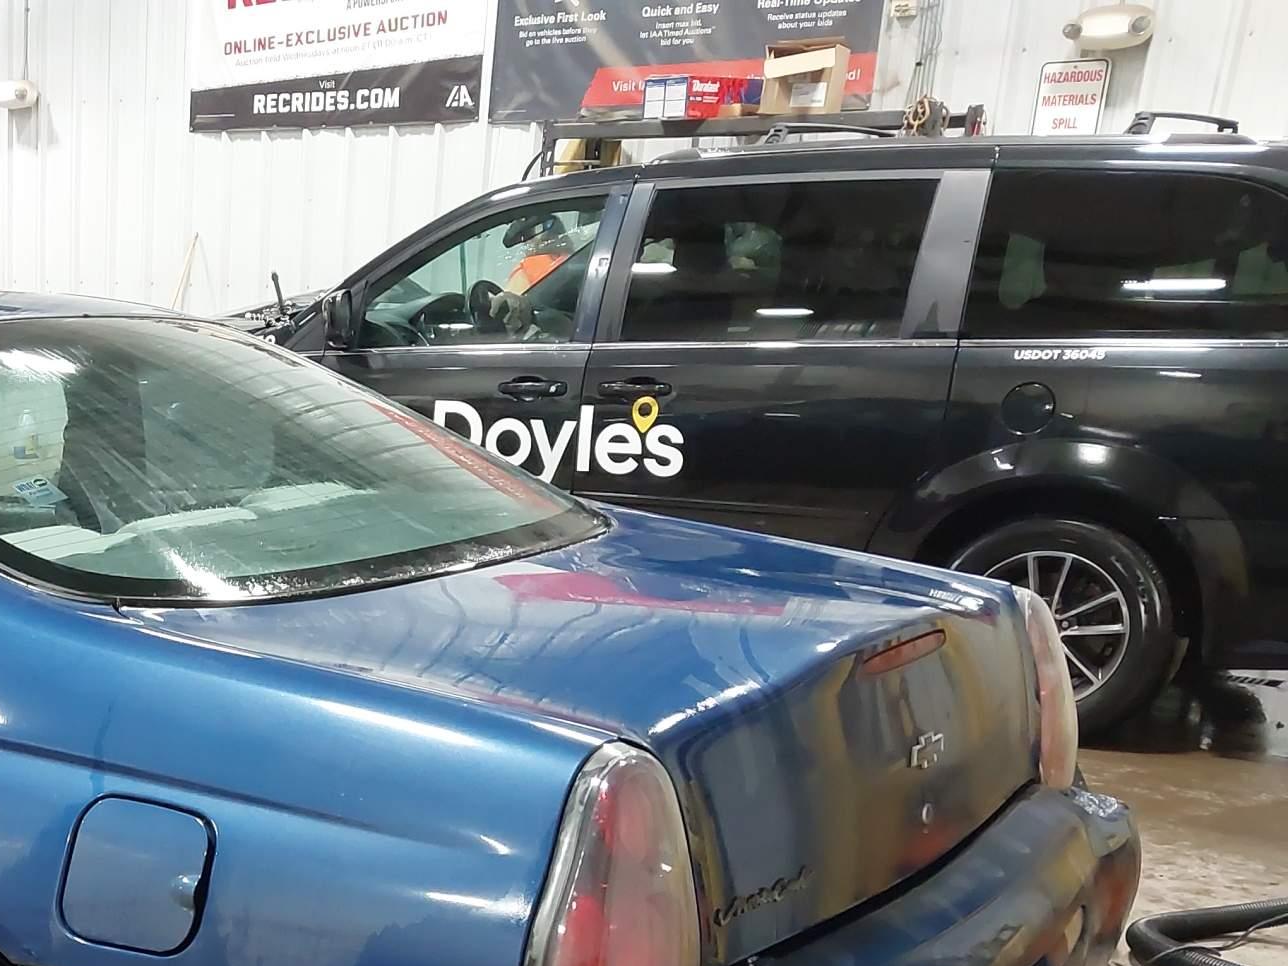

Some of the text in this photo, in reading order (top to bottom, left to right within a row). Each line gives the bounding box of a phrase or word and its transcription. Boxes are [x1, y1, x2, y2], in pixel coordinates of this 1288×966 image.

[642, 2, 719, 17] Quick and Easy
[818, 10, 847, 18] updates
[514, 10, 607, 26] Exclusive First Look
[800, 21, 815, 29] your
[224, 10, 448, 55] ONLINE-EXCLUSIVE AUCTION
[1044, 69, 1103, 84] HAZARDOUS
[319, 80, 335, 89] Visit
[613, 80, 635, 92] Visit
[253, 87, 400, 114] RECRIDES.COM
[1042, 93, 1097, 107] MATERIALS
[1052, 117, 1077, 129] SPILL
[1014, 350, 1061, 360] USDOT
